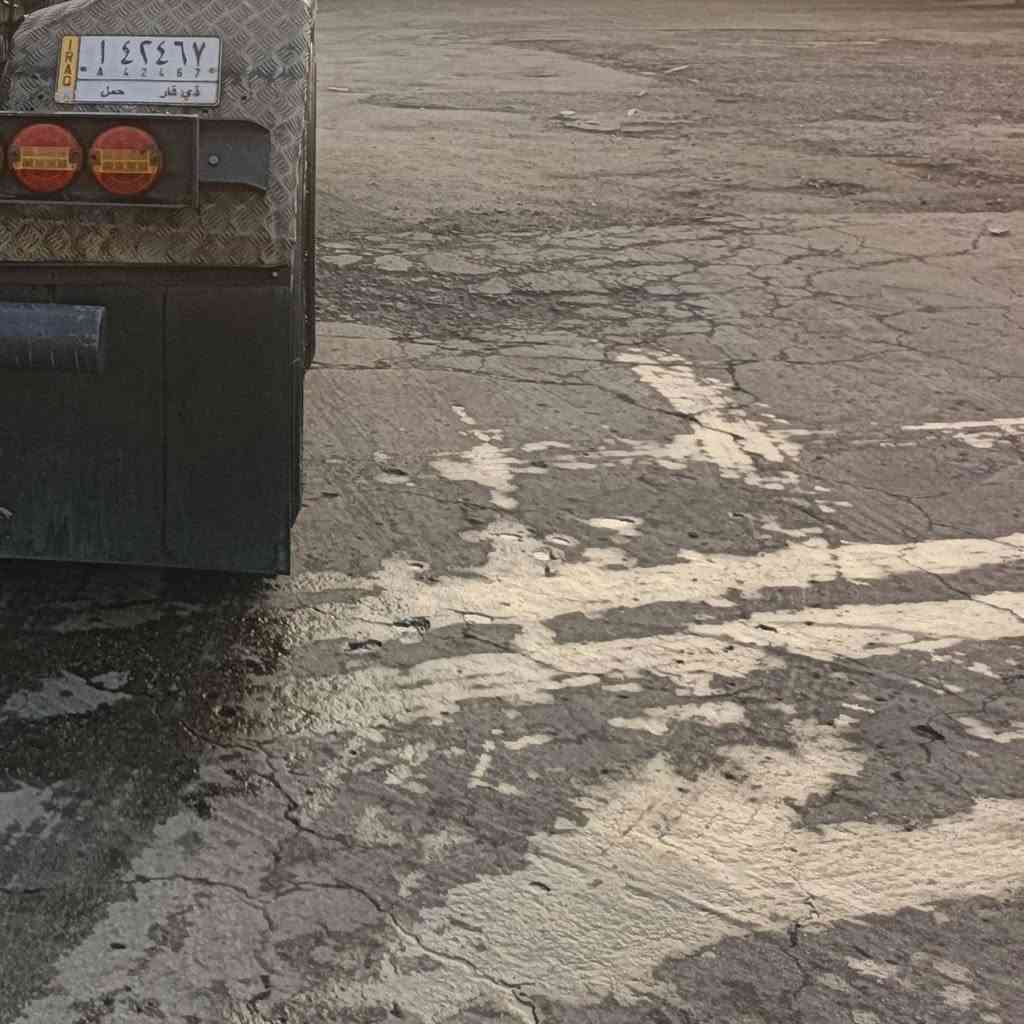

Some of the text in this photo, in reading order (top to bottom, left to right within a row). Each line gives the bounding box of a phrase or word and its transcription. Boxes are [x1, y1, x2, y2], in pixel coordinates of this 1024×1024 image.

[62, 39, 74, 87] IRAQ
[100, 85, 126, 98] حمل
[159, 85, 178, 99] قار
